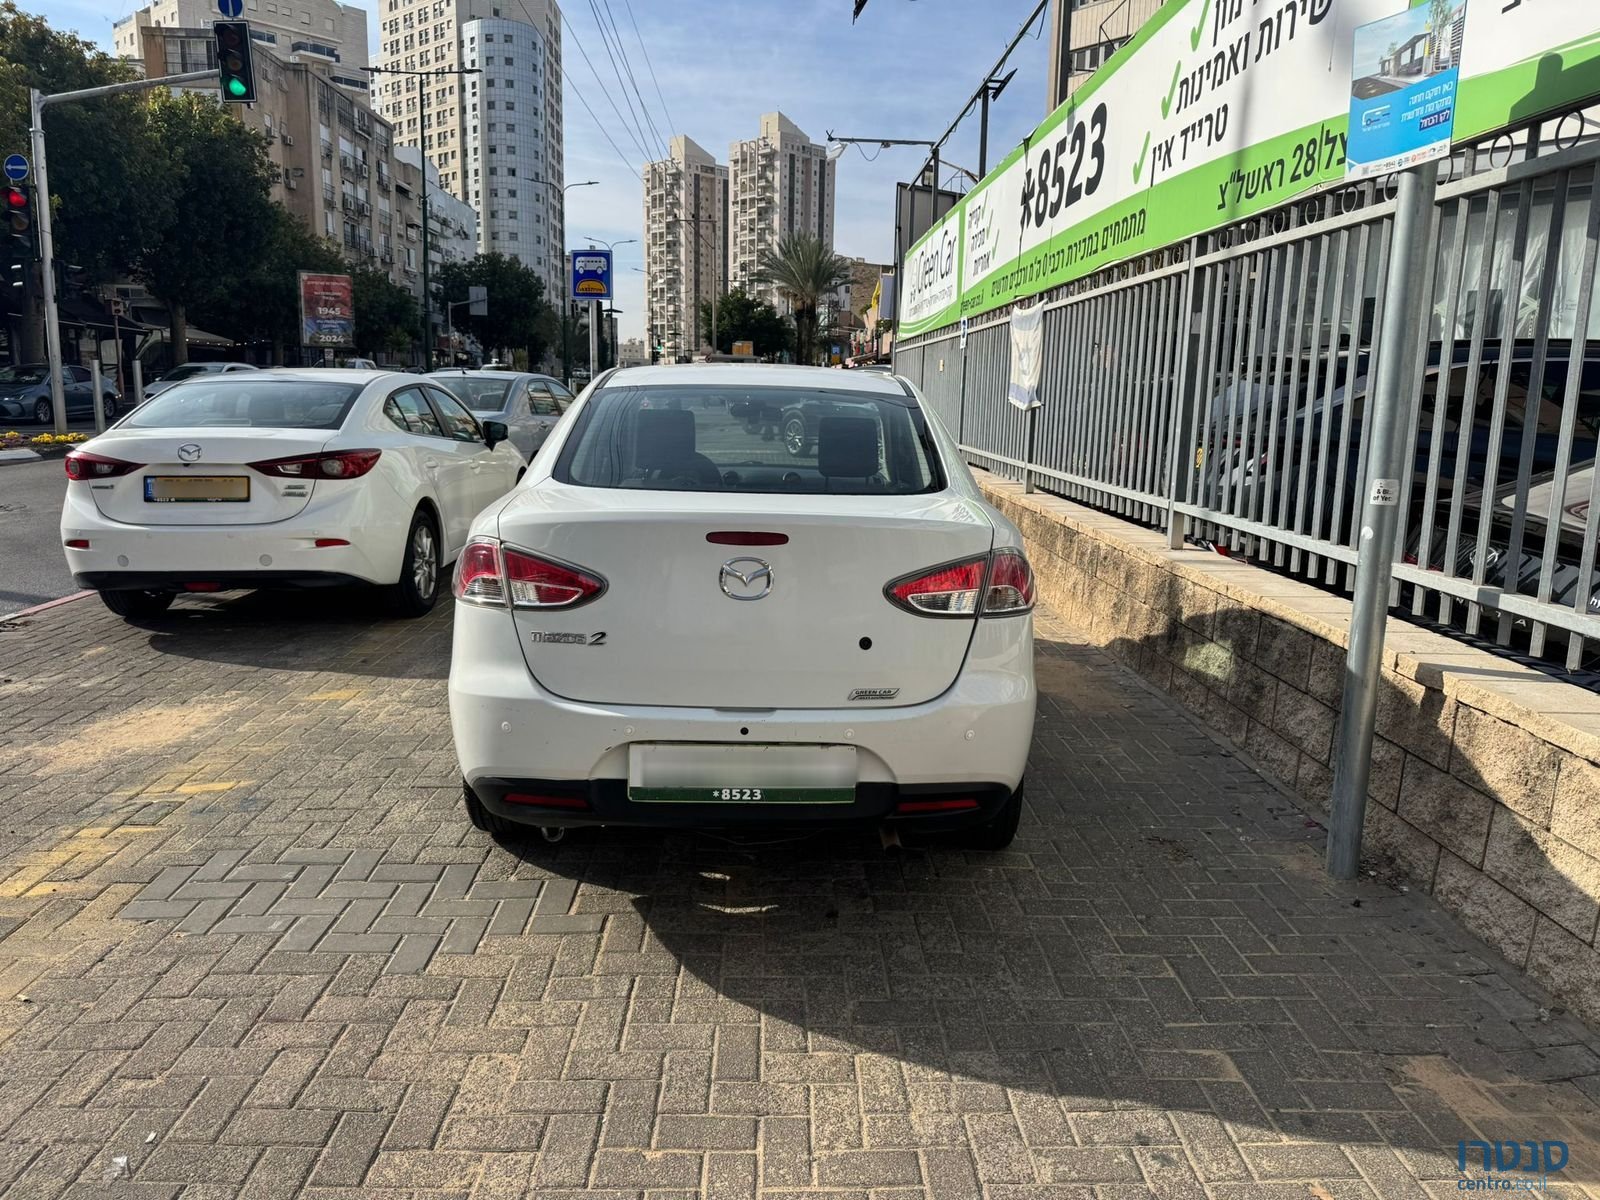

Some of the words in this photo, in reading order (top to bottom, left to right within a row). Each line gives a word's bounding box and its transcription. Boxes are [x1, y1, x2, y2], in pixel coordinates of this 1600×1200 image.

[1176, 31, 1250, 115] ואמינות
[1442, 81, 1453, 95] כאן
[1180, 103, 1228, 161] טרייד
[1150, 135, 1175, 188] אין
[1101, 208, 1146, 251] מתמחים
[917, 250, 939, 294] Green
[940, 229, 957, 280] Car
[1042, 252, 1048, 277] 0
[1049, 248, 1064, 274] רכבי
[1066, 231, 1099, 267] במכירת
[317, 307, 341, 315] 1945
[319, 334, 345, 343] 2024
